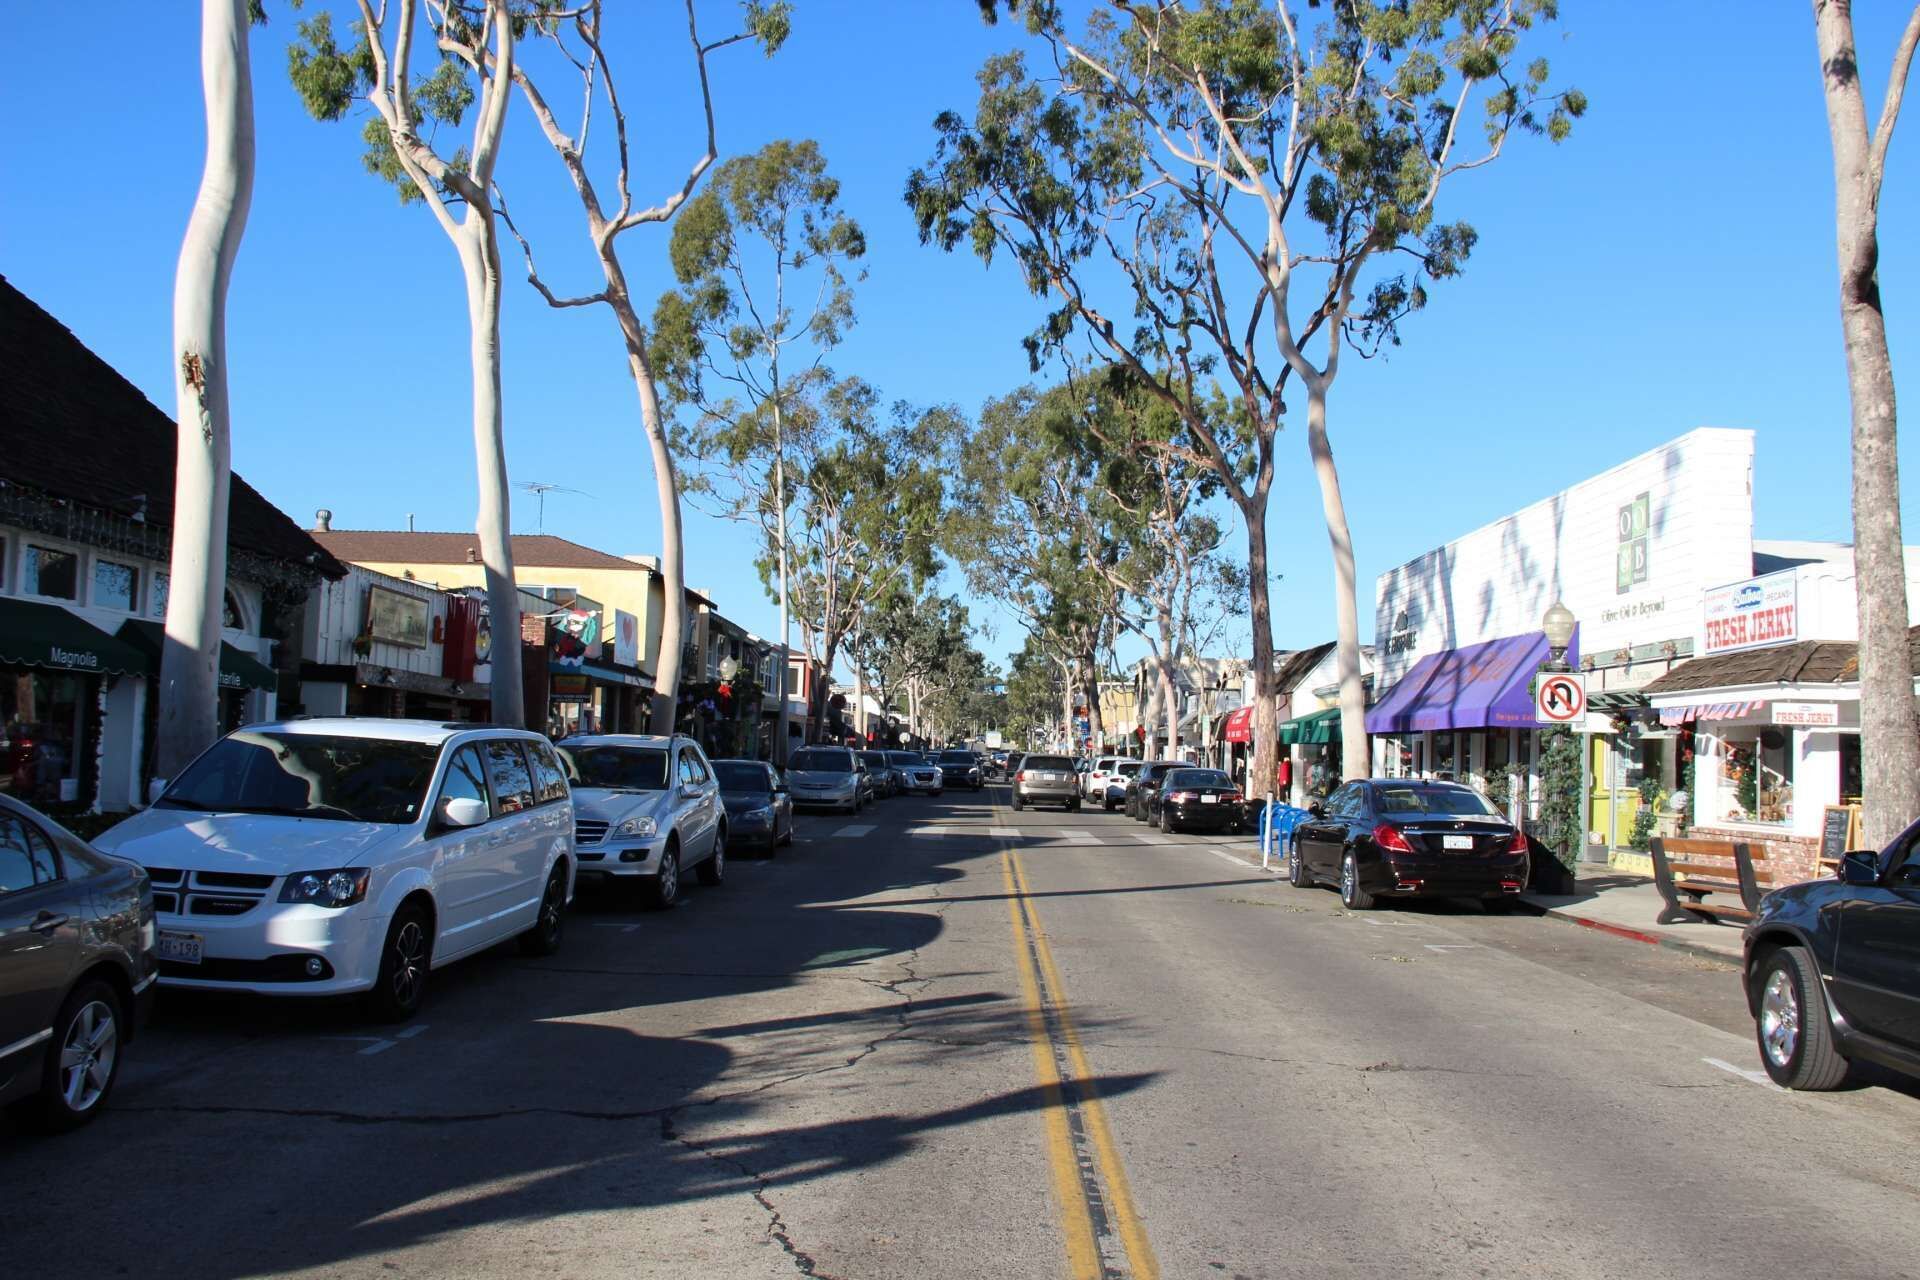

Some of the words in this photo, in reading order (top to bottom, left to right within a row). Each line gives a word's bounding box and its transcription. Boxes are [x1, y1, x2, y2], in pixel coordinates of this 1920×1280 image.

[1706, 614, 1747, 649] FRESH
[1750, 604, 1794, 641] JERKY
[51, 647, 97, 667] Magnolia
[219, 671, 241, 686] harlie
[1775, 711, 1805, 723] FRESH
[1807, 712, 1834, 724] JERKY
